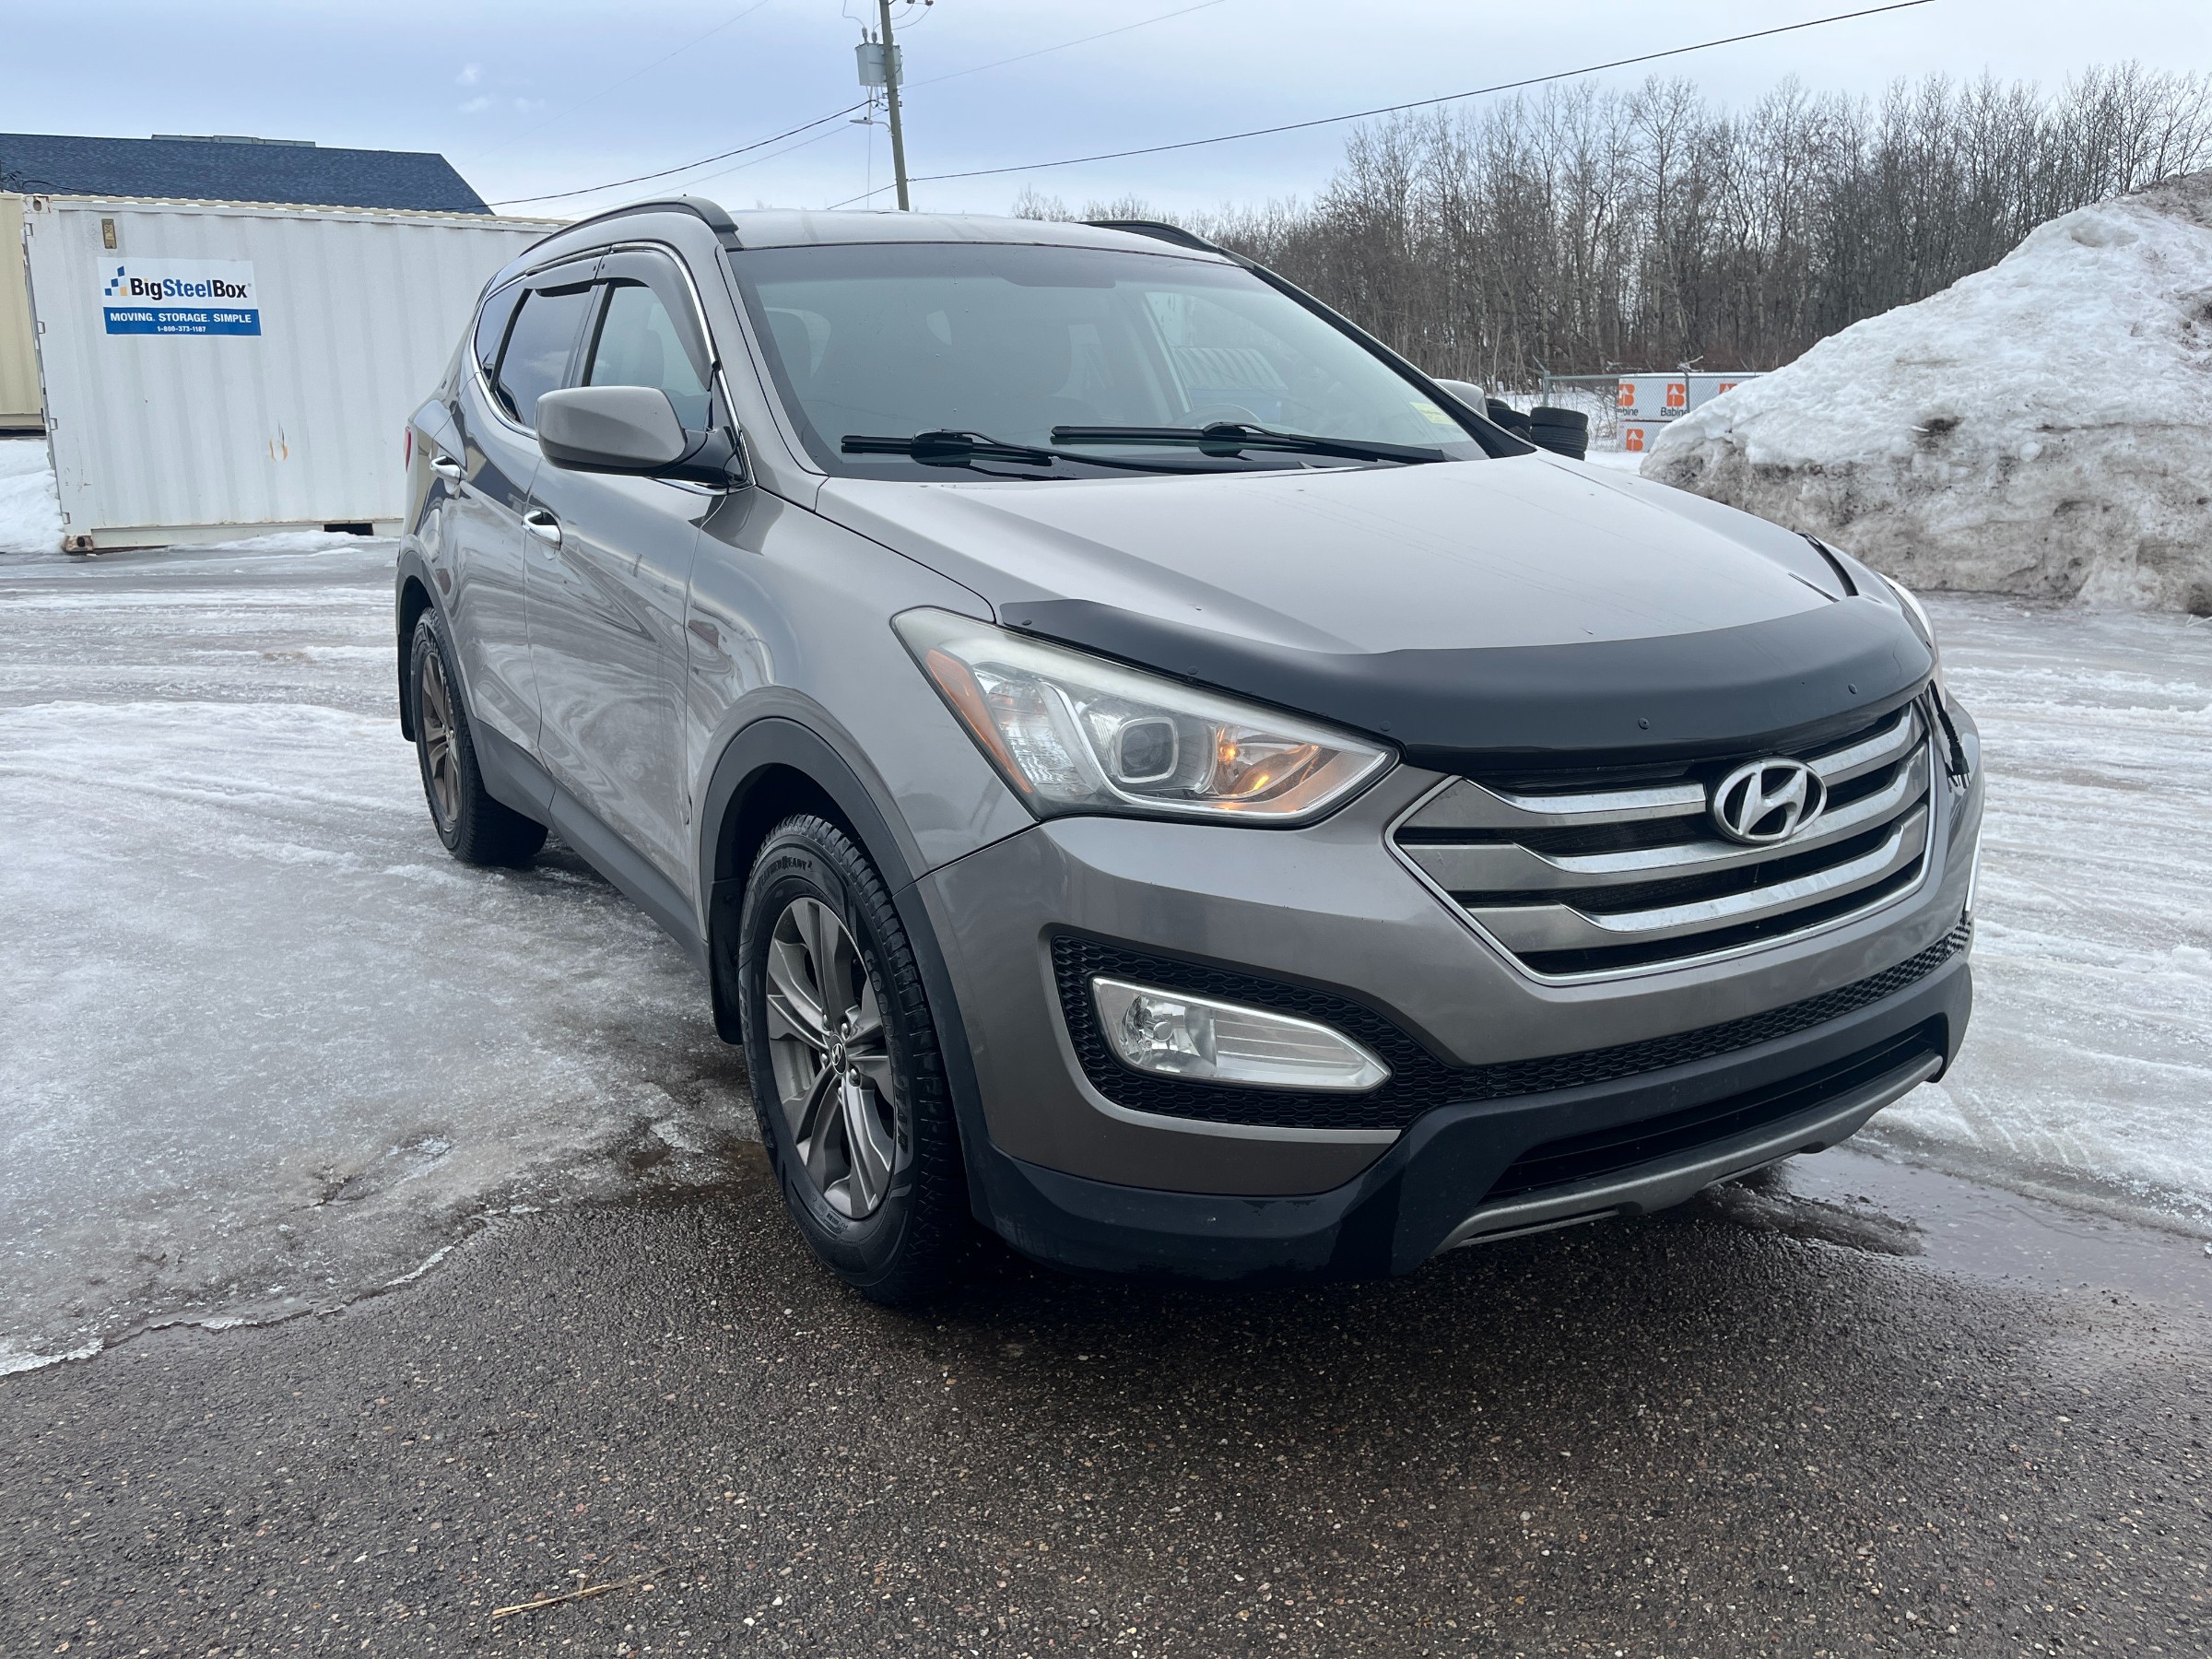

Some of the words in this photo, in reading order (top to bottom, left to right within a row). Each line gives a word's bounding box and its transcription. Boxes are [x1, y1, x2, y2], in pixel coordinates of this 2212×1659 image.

[130, 277, 248, 300] BigSteelBox
[110, 312, 155, 322] MOVING.
[158, 312, 211, 323] STORAGE.
[213, 313, 253, 323] SIMPLE
[1617, 407, 1639, 417] bine
